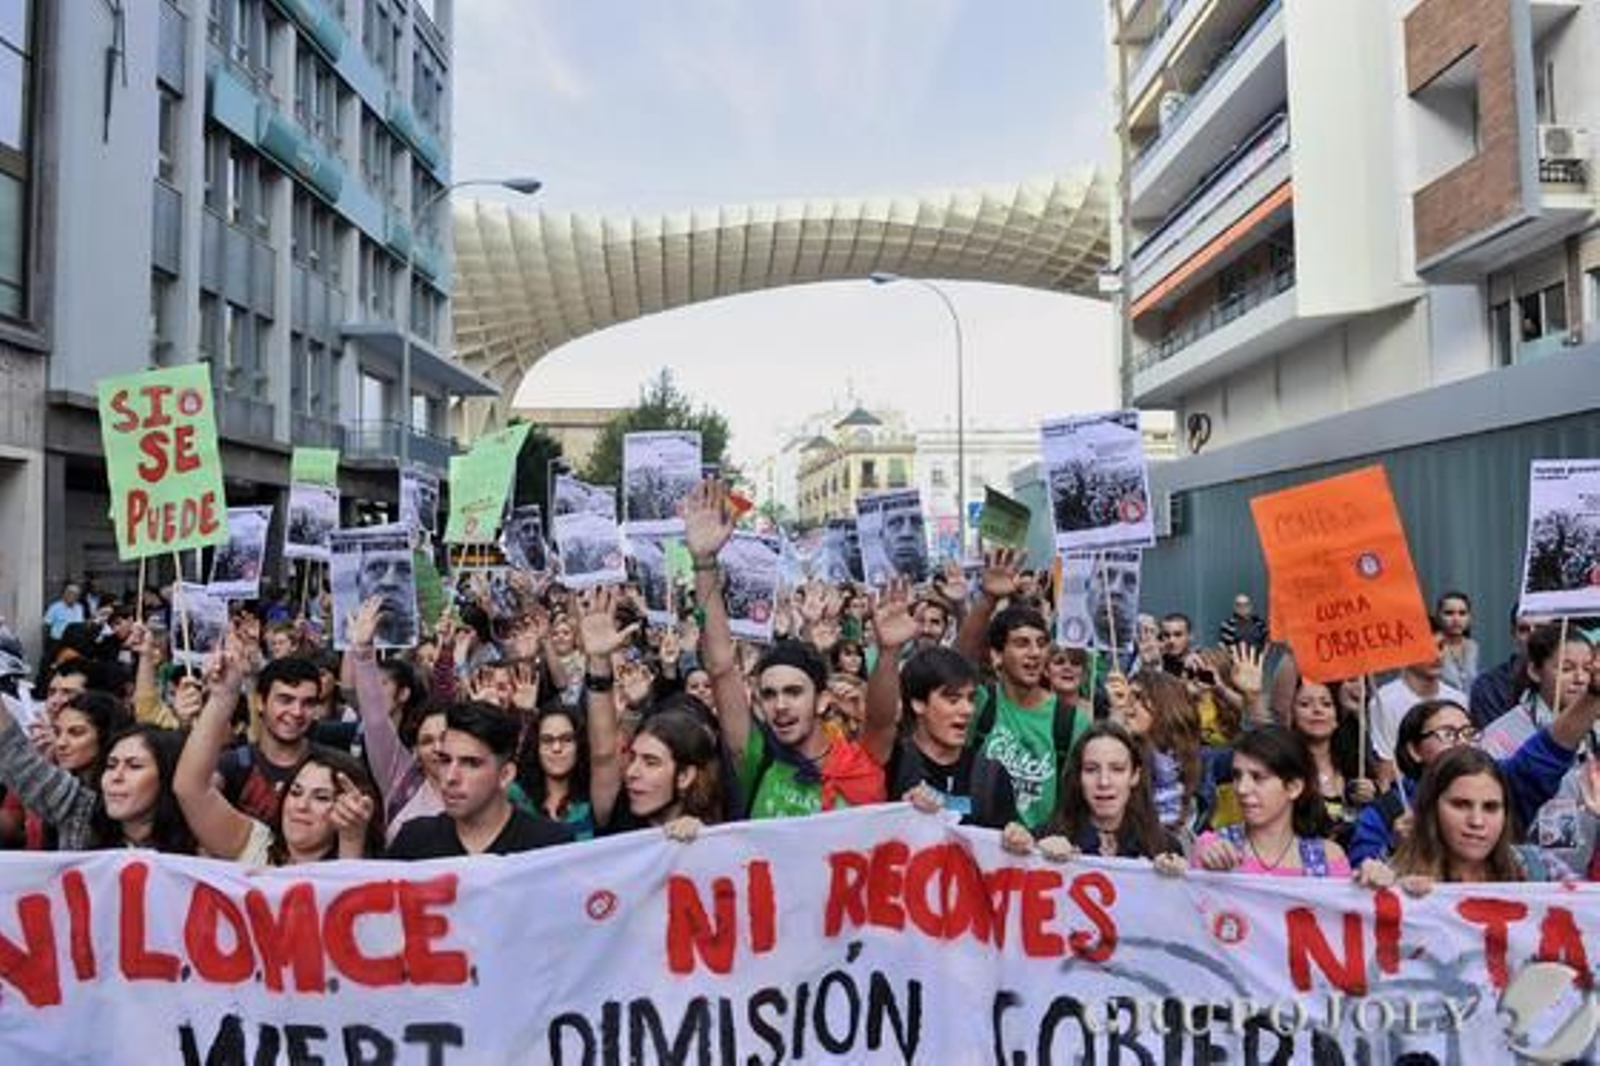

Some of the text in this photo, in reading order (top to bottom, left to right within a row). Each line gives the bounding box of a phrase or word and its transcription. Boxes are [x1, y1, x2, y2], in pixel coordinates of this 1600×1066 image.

[110, 385, 173, 433] SI
[137, 425, 201, 483] SE
[126, 488, 220, 547] PUEDE
[1315, 619, 1414, 663] OBRERA
[666, 861, 776, 974] NI
[1285, 886, 1402, 997] NI
[548, 940, 922, 1066] DIMISIÓN
